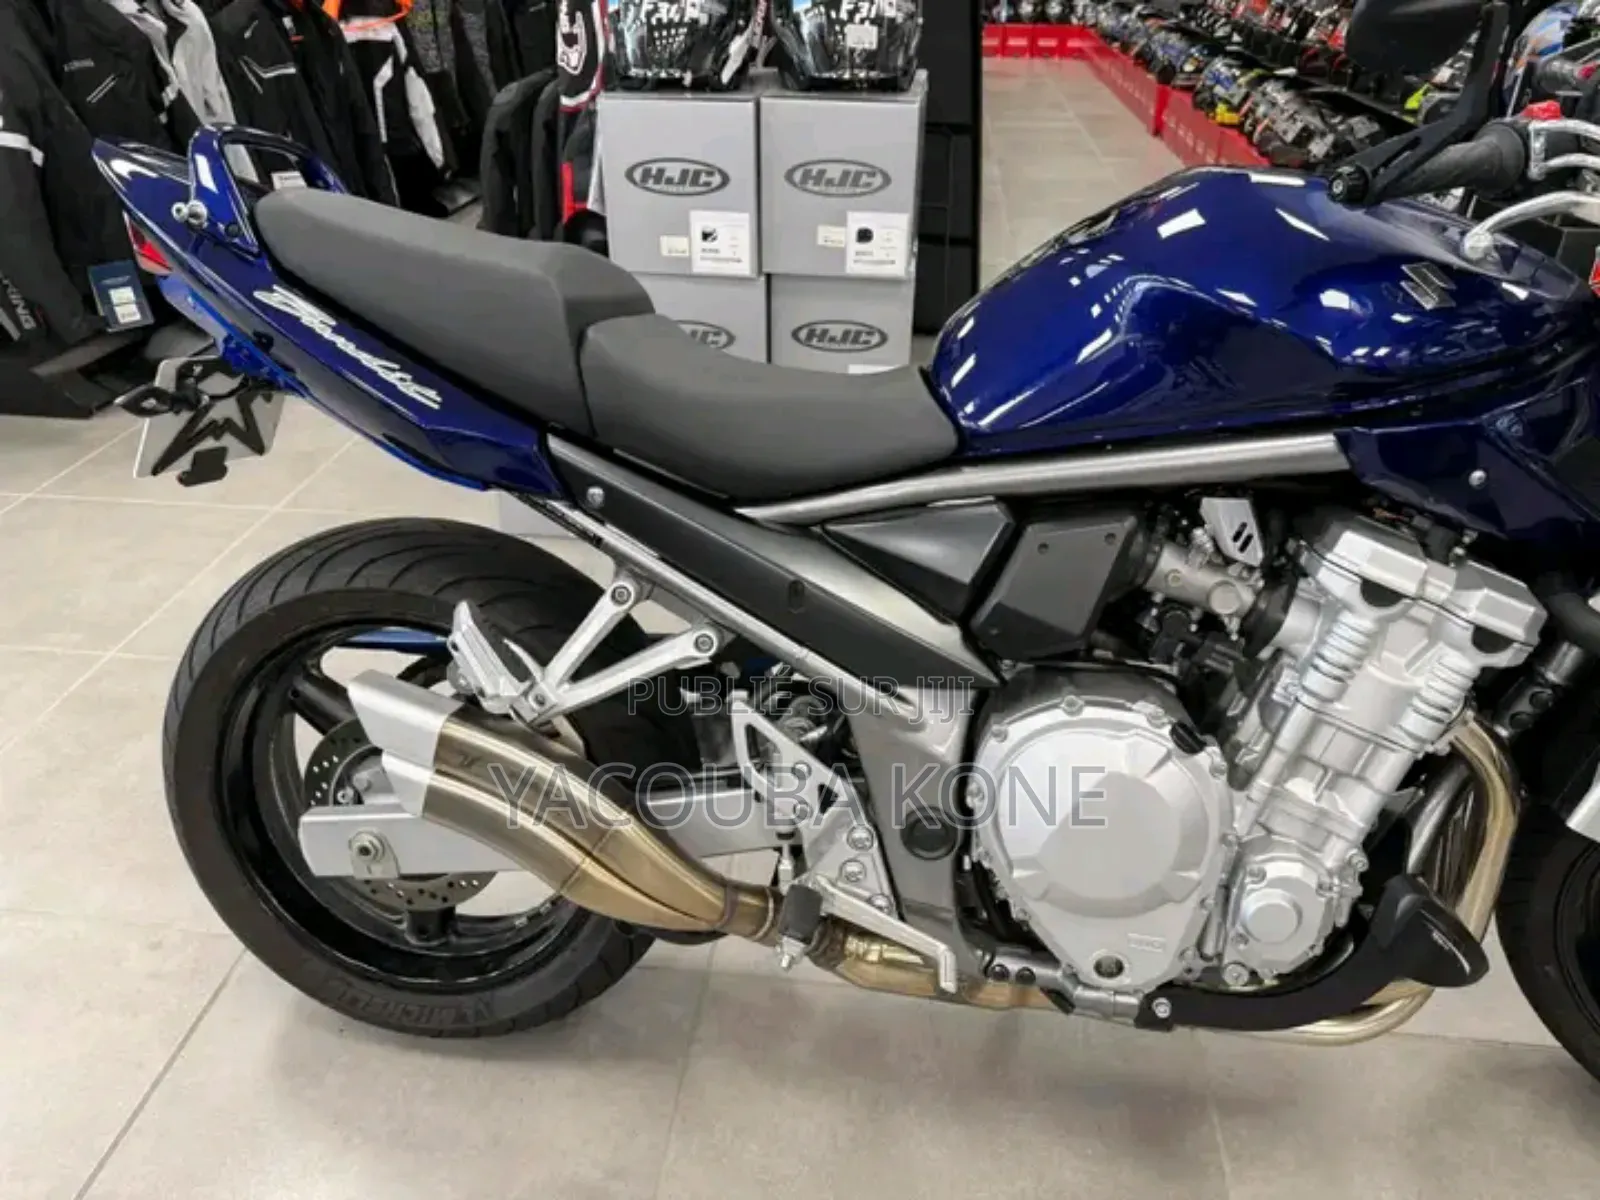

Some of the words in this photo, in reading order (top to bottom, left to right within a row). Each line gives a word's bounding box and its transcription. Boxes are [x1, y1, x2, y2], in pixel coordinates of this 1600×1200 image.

[640, 166, 716, 188] HJC
[799, 168, 876, 189] HJC
[803, 328, 875, 346] HJC
